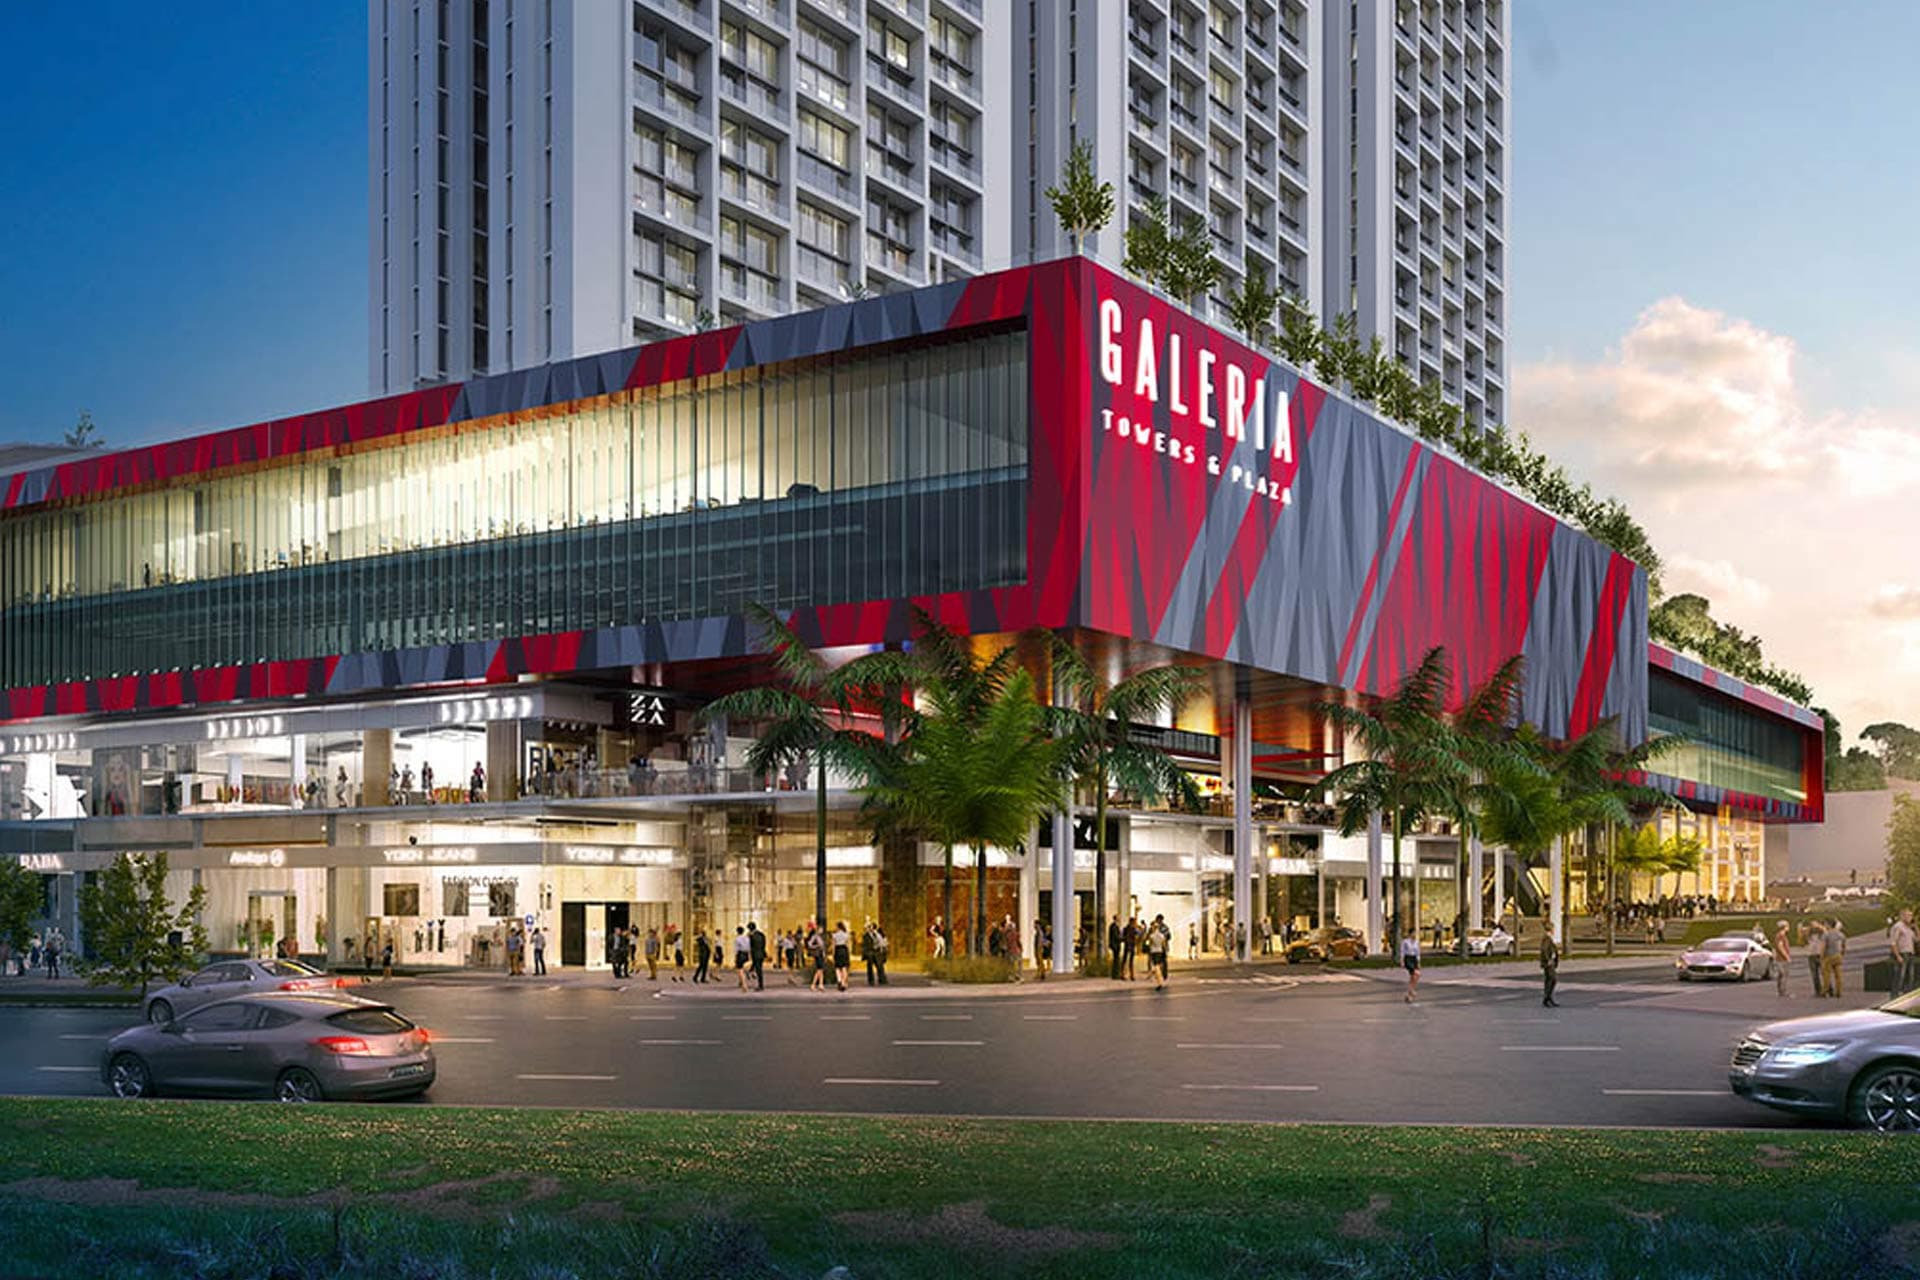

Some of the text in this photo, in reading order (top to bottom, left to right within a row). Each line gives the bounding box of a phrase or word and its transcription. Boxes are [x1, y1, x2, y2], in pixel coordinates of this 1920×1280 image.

[1101, 298, 1292, 463] GALERIA
[1101, 408, 1292, 505] TOWERS & PLAZA
[426, 848, 477, 862] JEANS
[619, 847, 673, 863] JEANS
